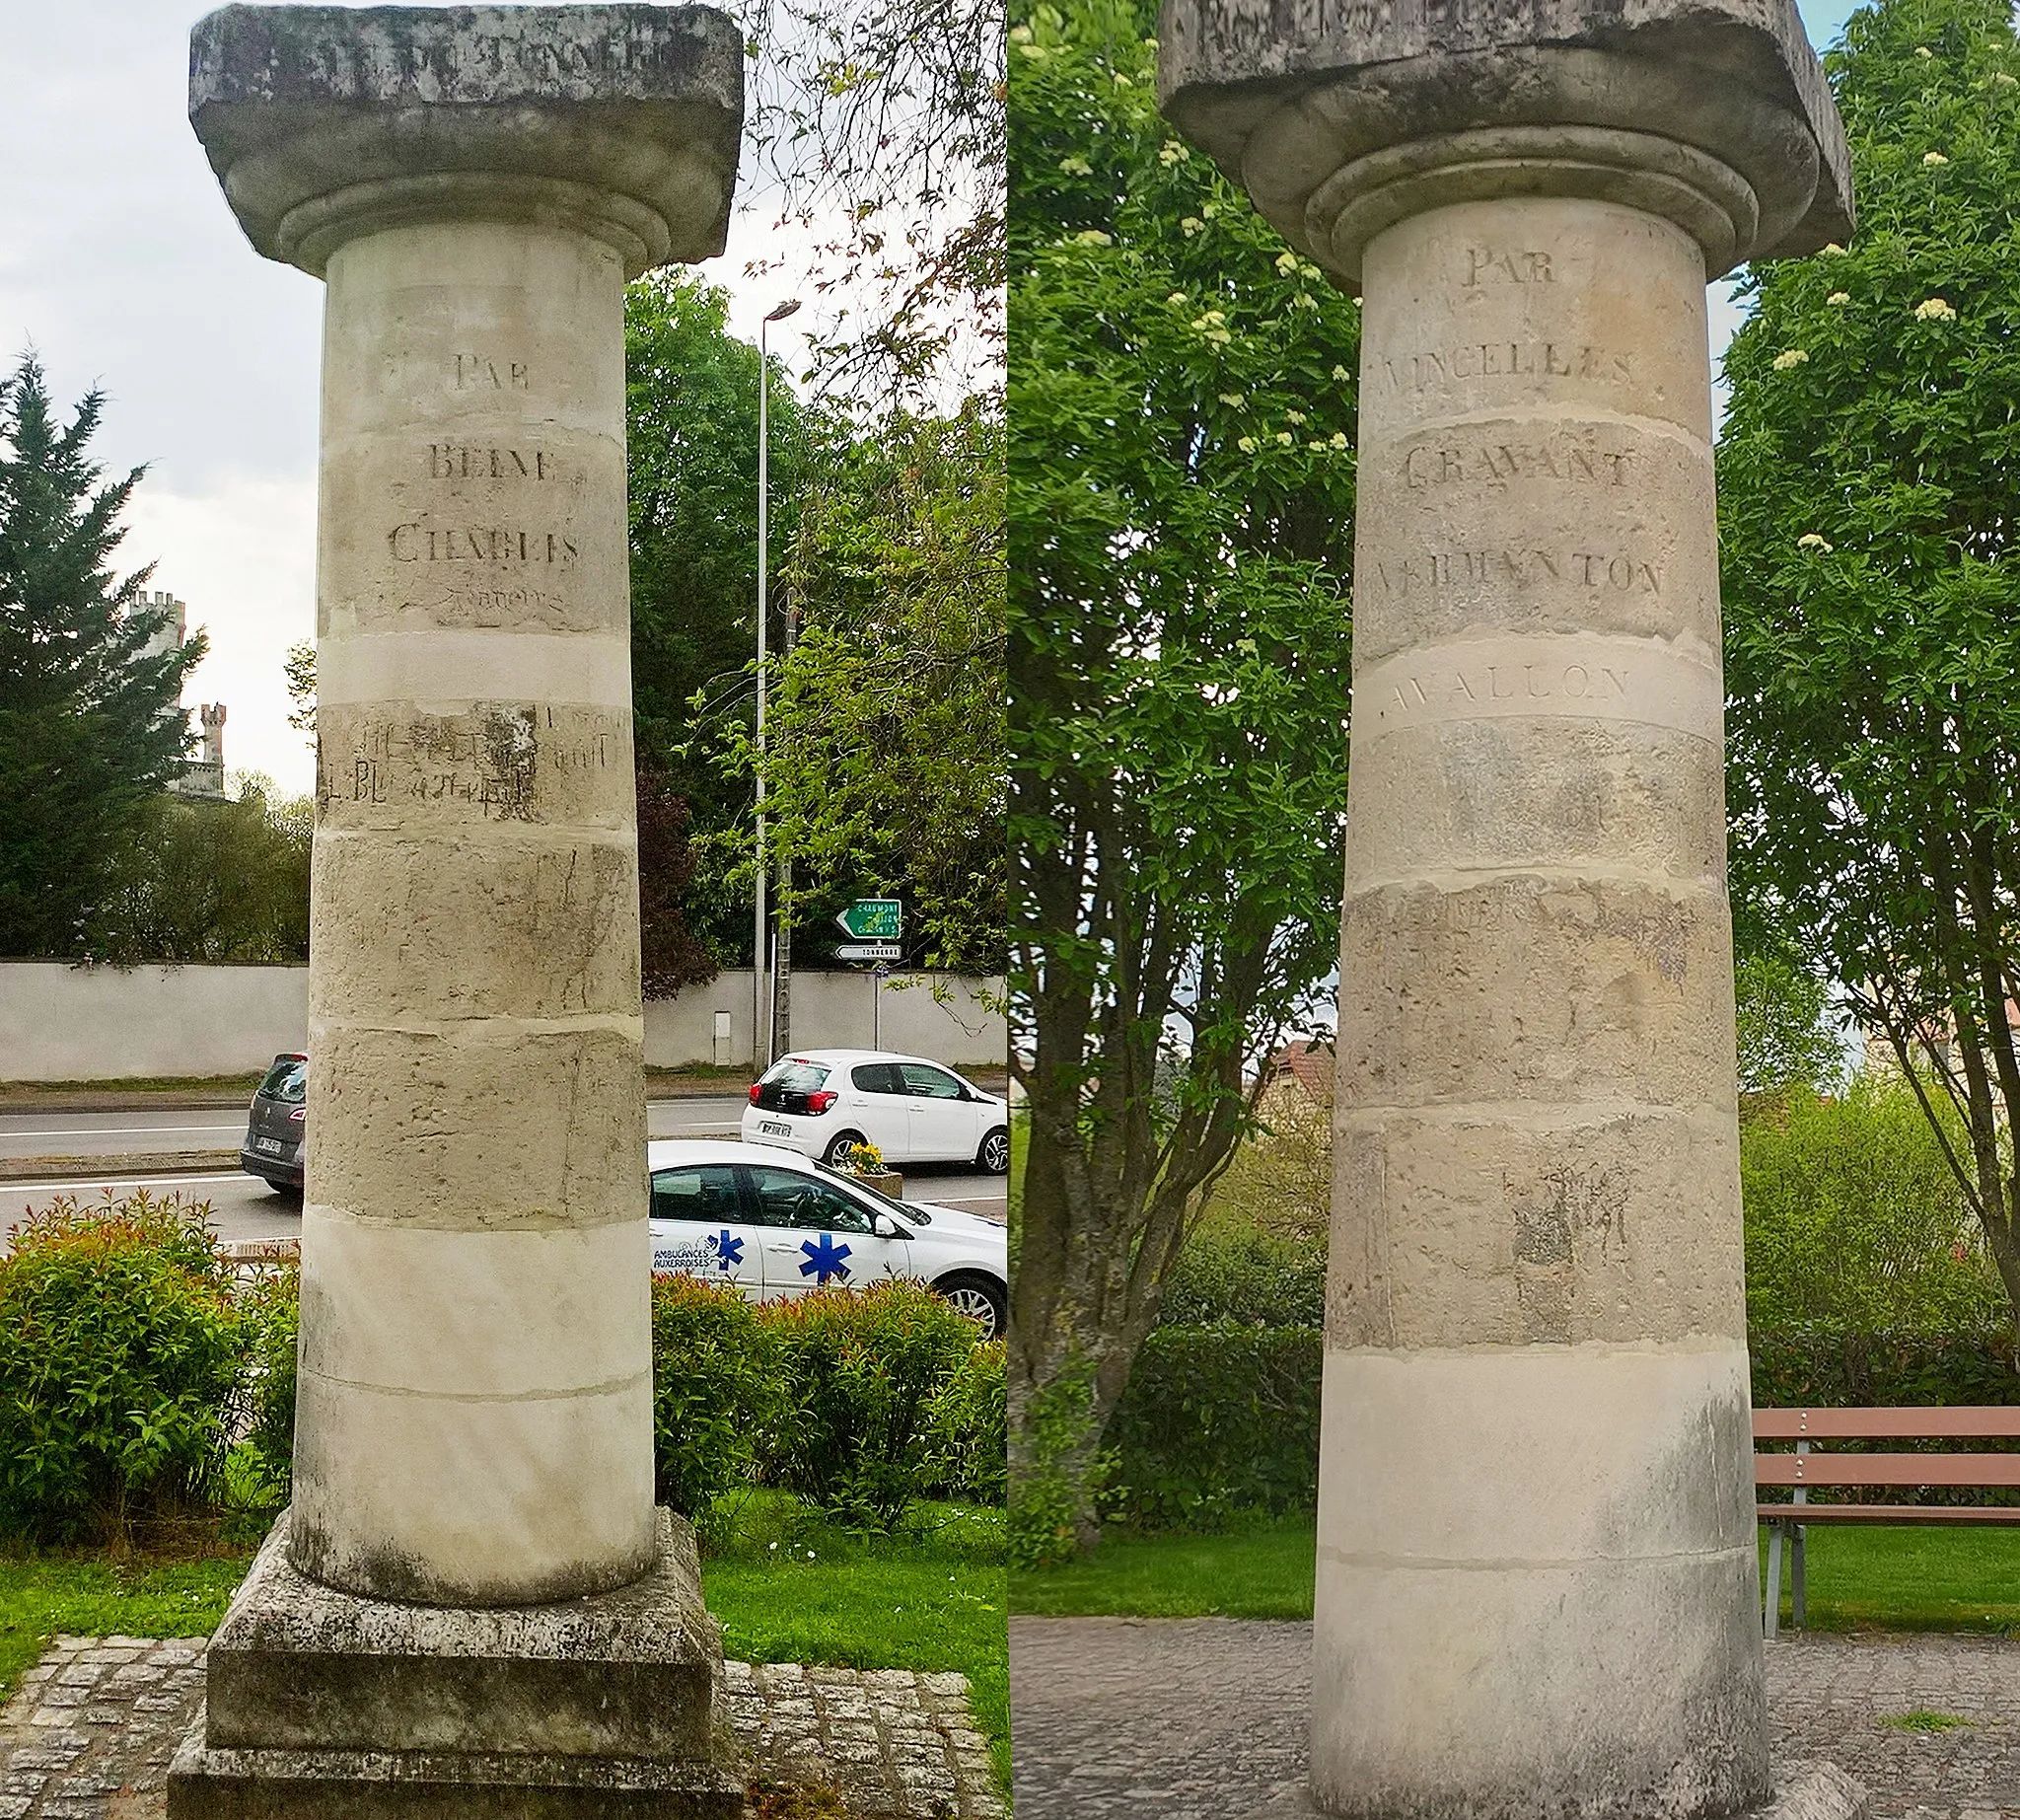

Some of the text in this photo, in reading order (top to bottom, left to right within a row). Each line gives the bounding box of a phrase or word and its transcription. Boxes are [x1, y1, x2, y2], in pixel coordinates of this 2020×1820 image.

[1461, 248, 1556, 287] PAR
[453, 353, 529, 391] PAR
[654, 1250, 708, 1259] AMBULANCES
[654, 1259, 709, 1268] AUXERROISES
